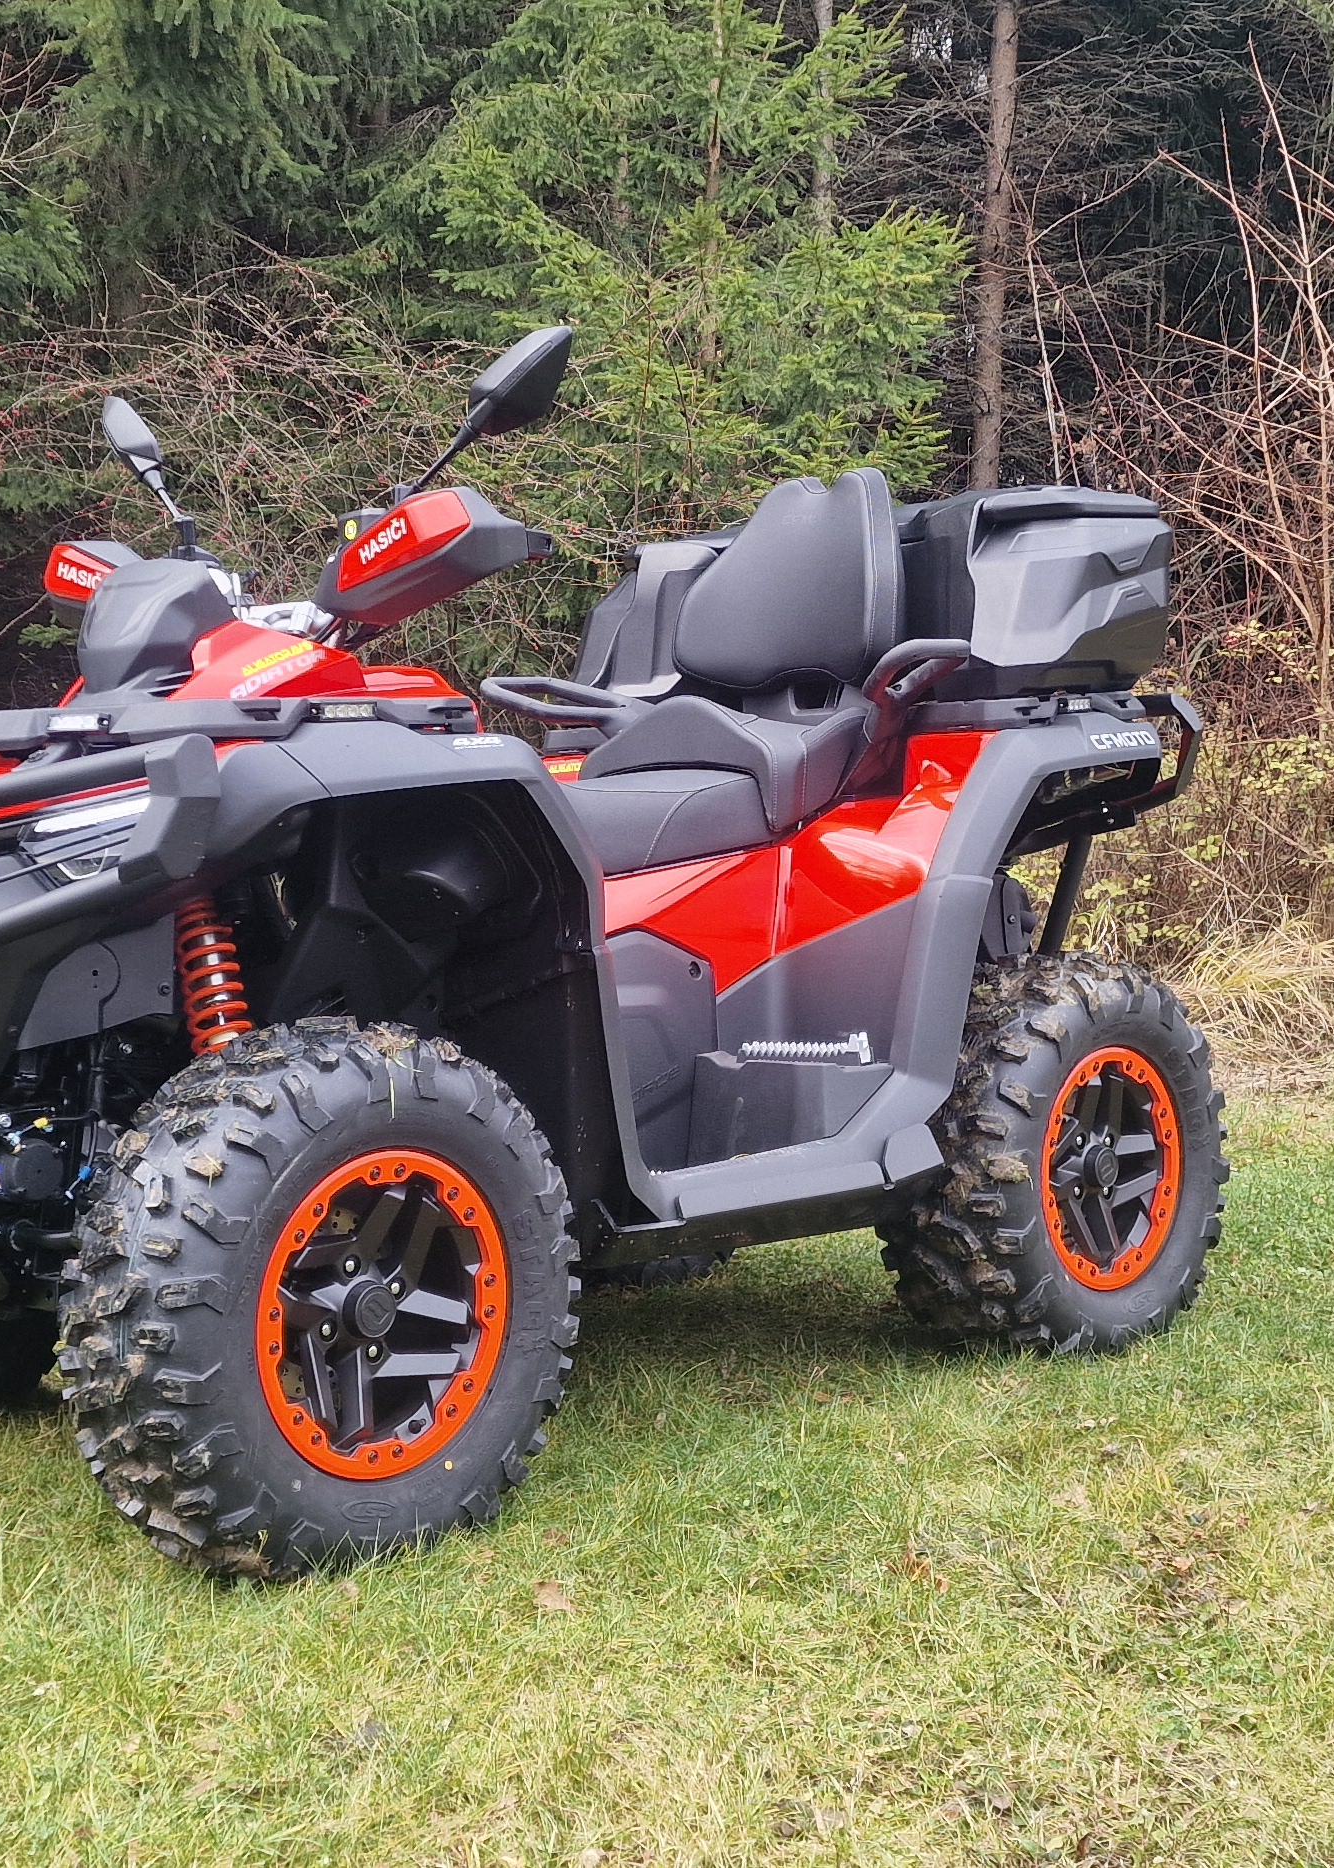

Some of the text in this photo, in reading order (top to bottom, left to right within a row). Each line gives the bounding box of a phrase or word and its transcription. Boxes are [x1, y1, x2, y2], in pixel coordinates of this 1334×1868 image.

[358, 517, 407, 565] HASIČI
[57, 561, 102, 590] HASIČ
[230, 649, 326, 699] ADIATOR
[1089, 730, 1156, 750] CFMOTO
[631, 1064, 681, 1103] ORCE
